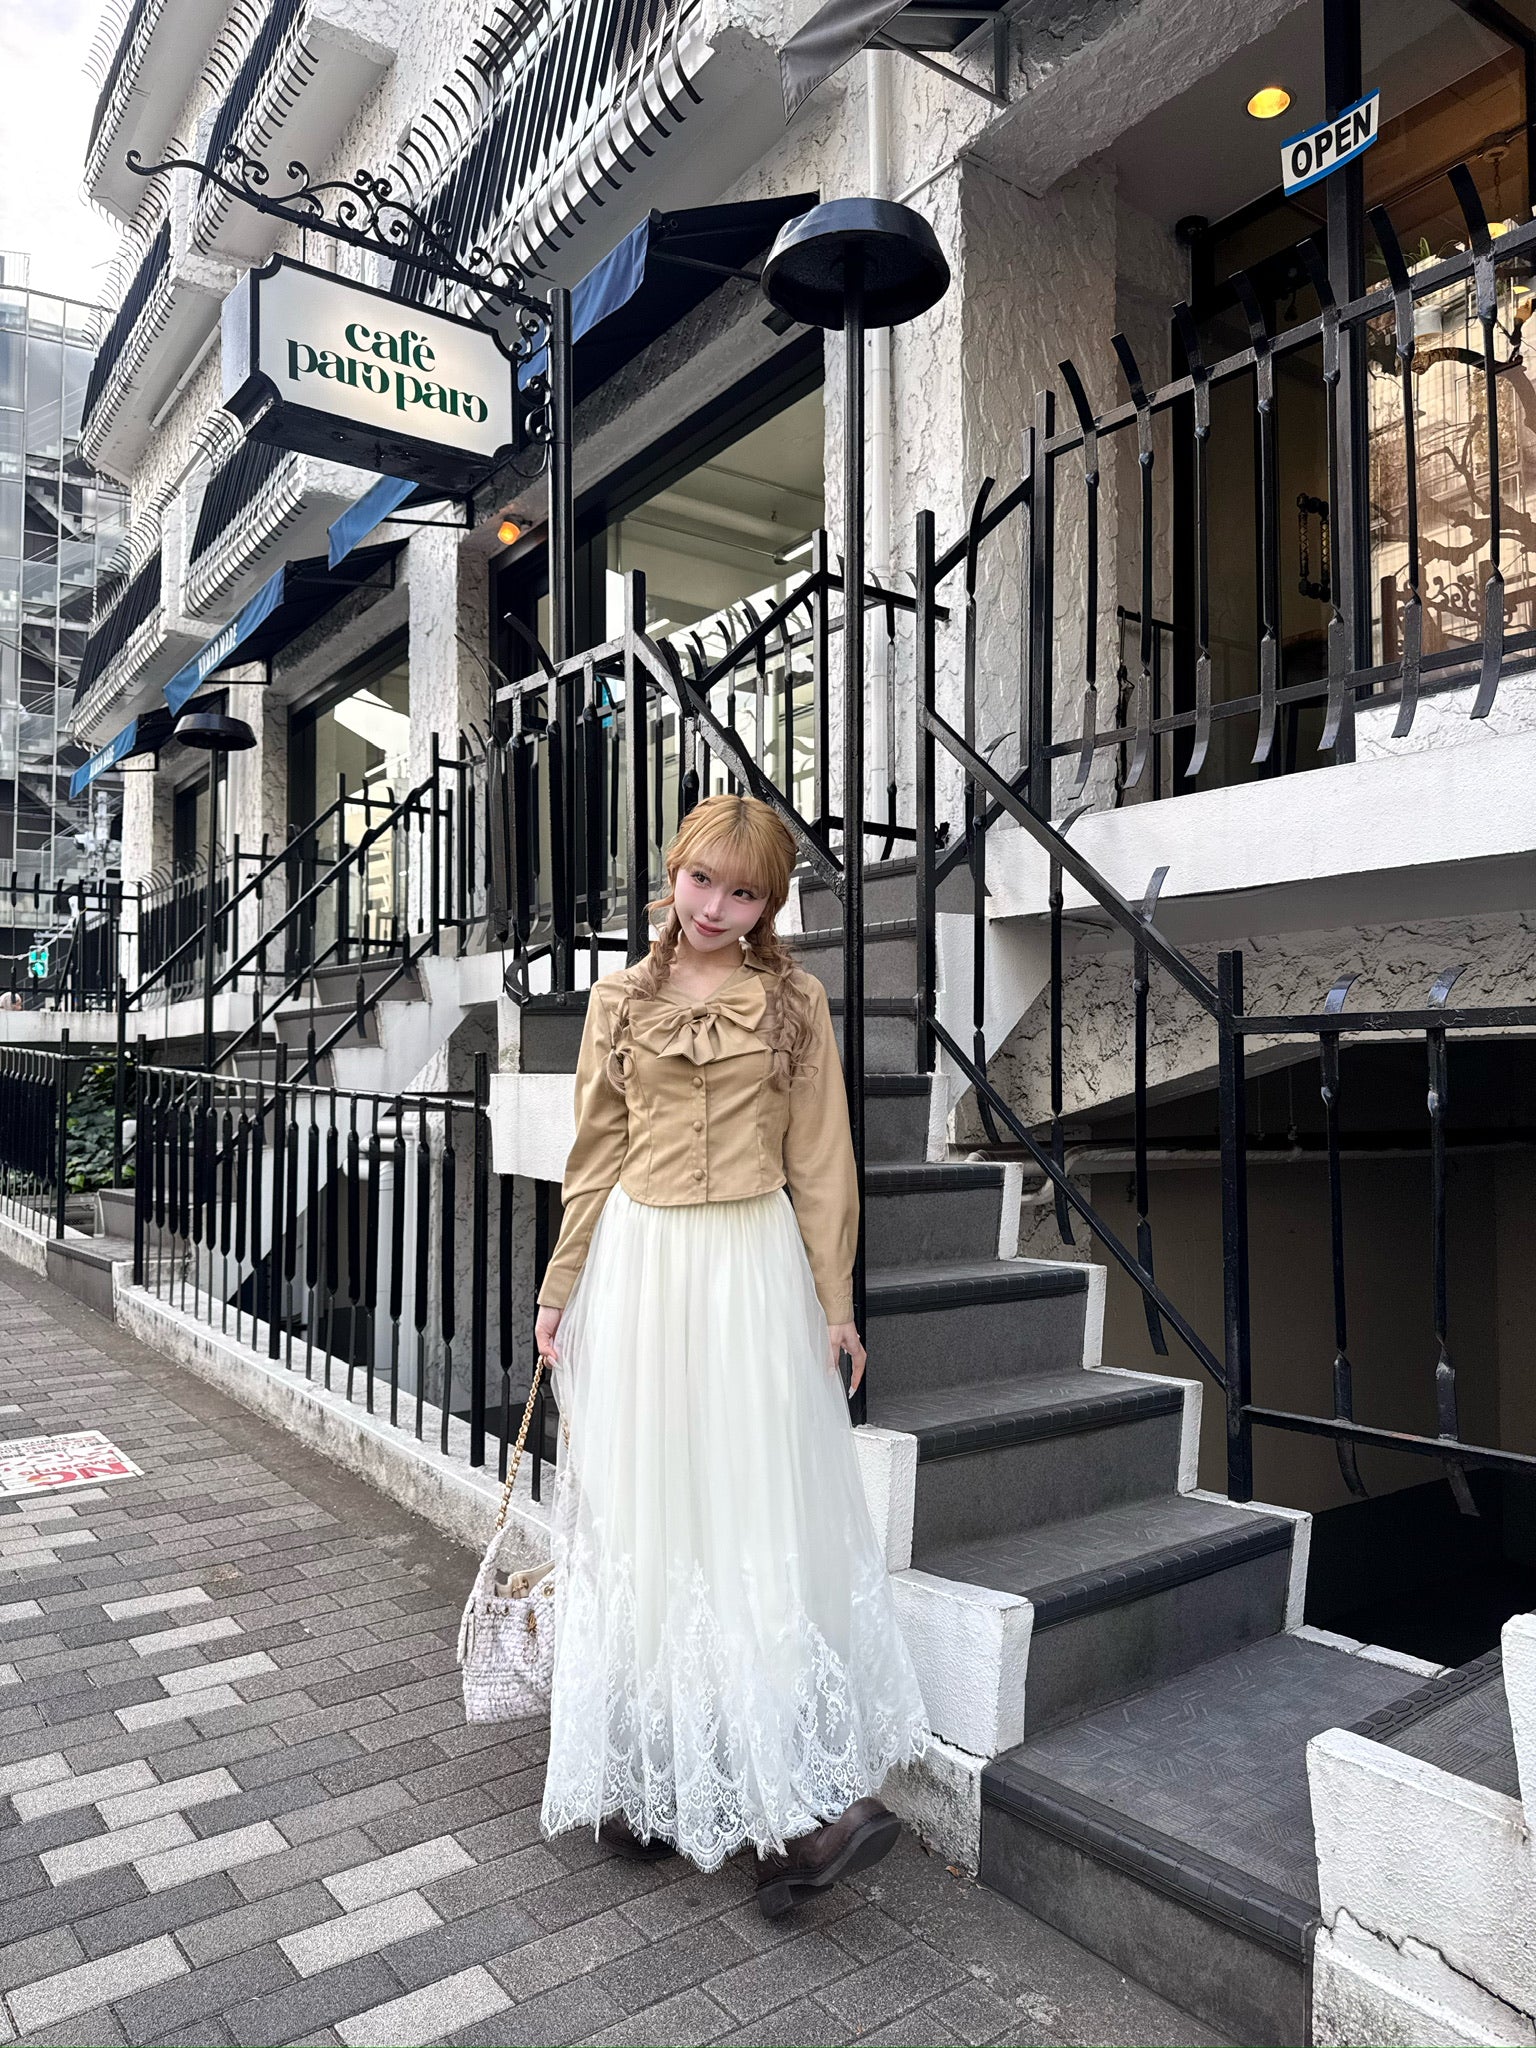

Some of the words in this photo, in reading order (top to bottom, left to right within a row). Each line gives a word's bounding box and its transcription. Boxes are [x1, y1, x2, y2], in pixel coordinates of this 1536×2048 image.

[1291, 103, 1371, 178] OPEN
[287, 338, 390, 394] paro
[394, 371, 488, 423] paro
[345, 323, 436, 372] café
